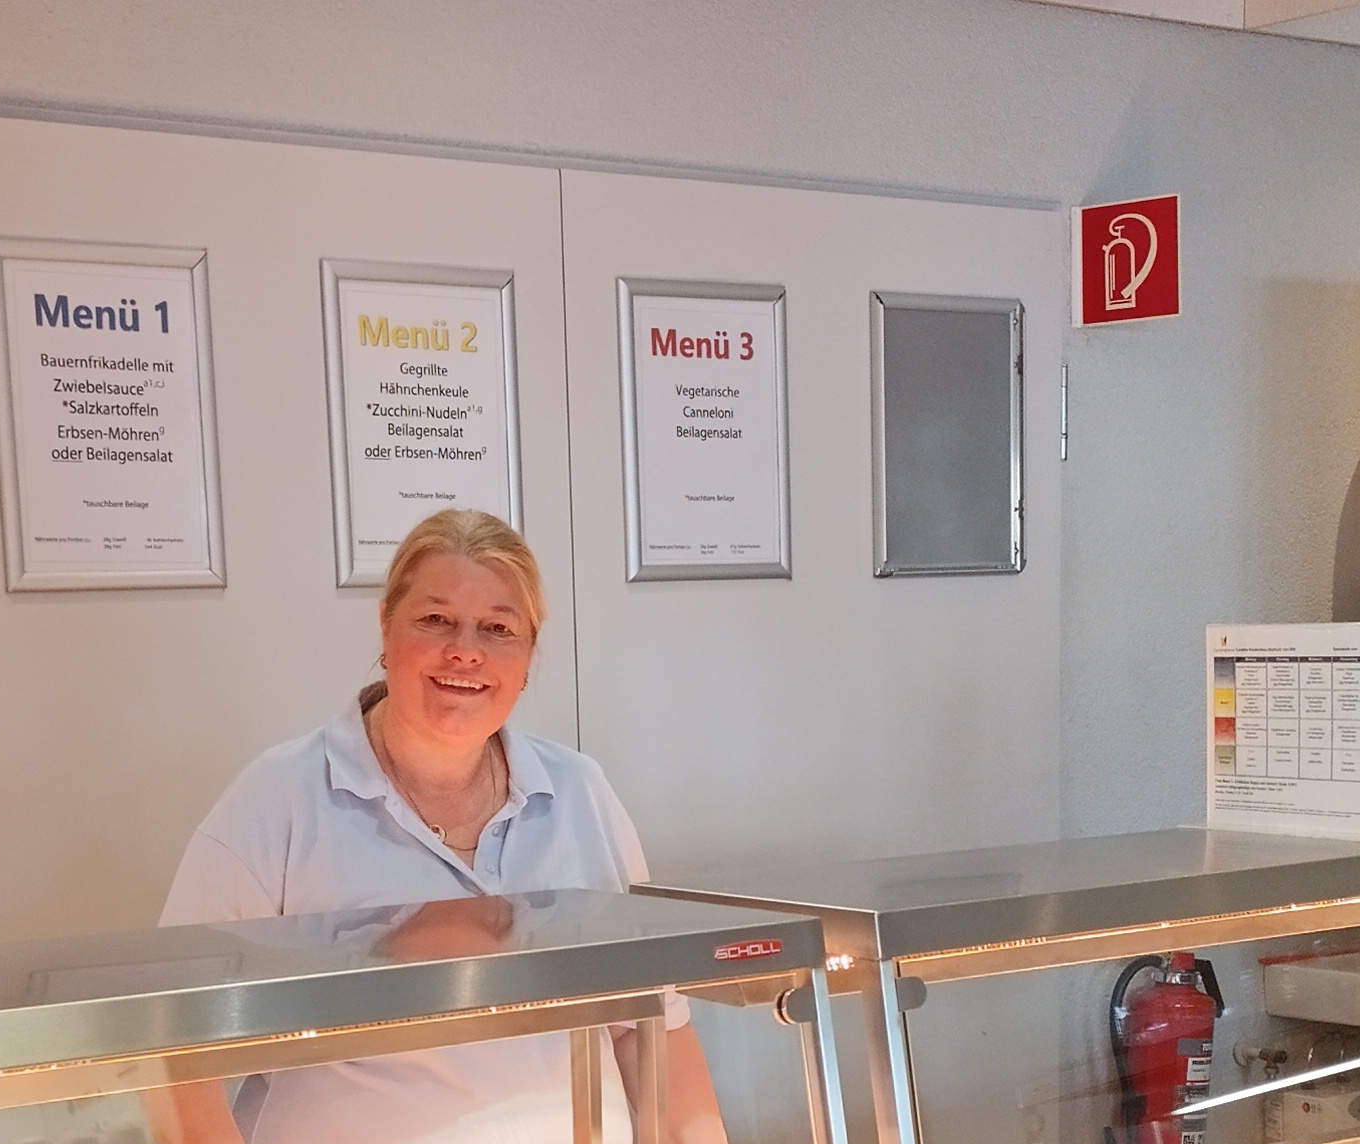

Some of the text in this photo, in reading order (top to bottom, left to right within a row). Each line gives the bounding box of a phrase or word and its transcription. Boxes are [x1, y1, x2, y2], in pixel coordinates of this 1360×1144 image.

[34, 293, 169, 334] Menü 1
[357, 314, 478, 353] Menü 2
[650, 327, 754, 361] Menü 3
[40, 353, 174, 373] Bauernfrikadelle mit
[400, 362, 448, 379] Gegrillte
[380, 381, 470, 398] Hähnchenkeule
[675, 384, 740, 400] Vegetarische
[682, 405, 734, 419] Canneloni
[387, 422, 464, 440] Beilagensalat
[676, 425, 743, 441] Beilagensalat
[51, 446, 174, 465] oder Beilagensalat
[364, 444, 392, 460] oder
[125, 500, 149, 509] Beilage
[714, 942, 781, 960] SCHOLL
